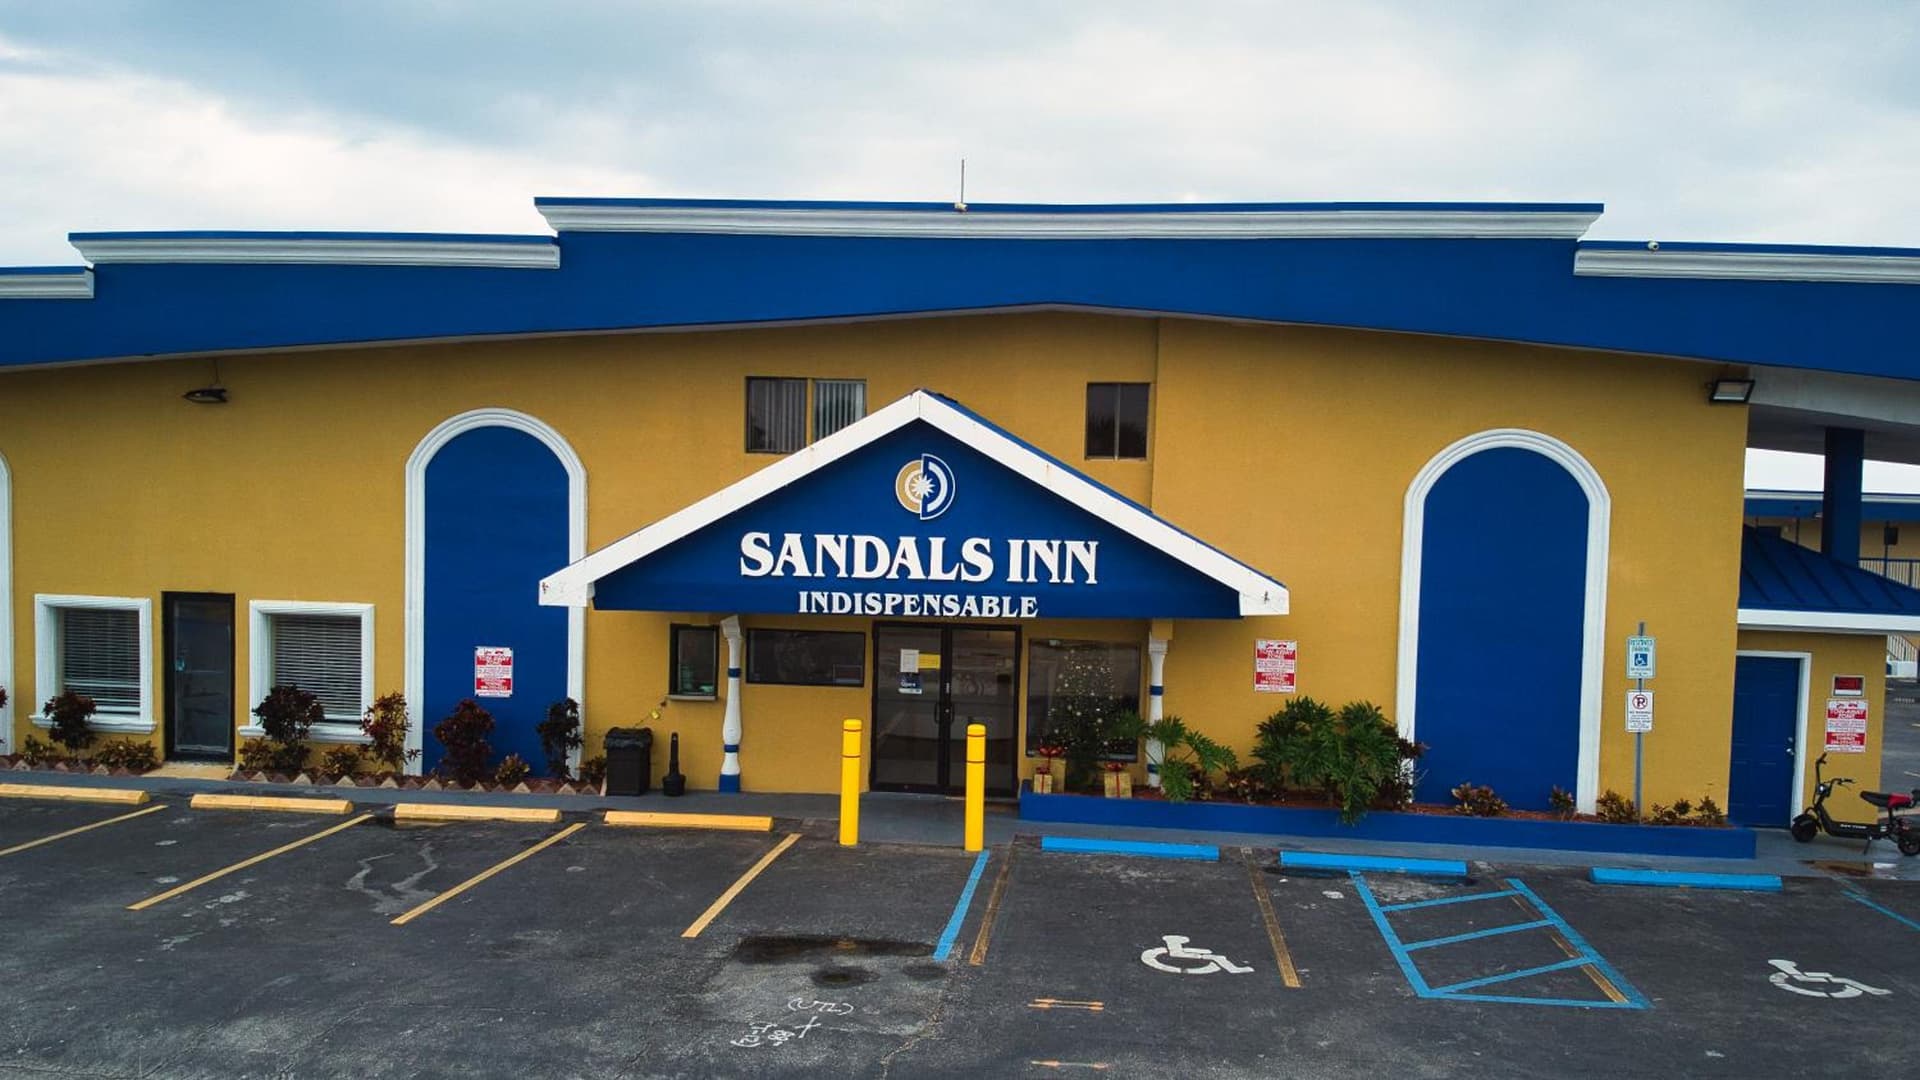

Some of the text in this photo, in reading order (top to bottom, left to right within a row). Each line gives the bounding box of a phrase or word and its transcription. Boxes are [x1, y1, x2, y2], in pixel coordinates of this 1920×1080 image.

[740, 531, 1099, 584] SANDALS INN
[798, 591, 1038, 618] INDISPENSABLE
